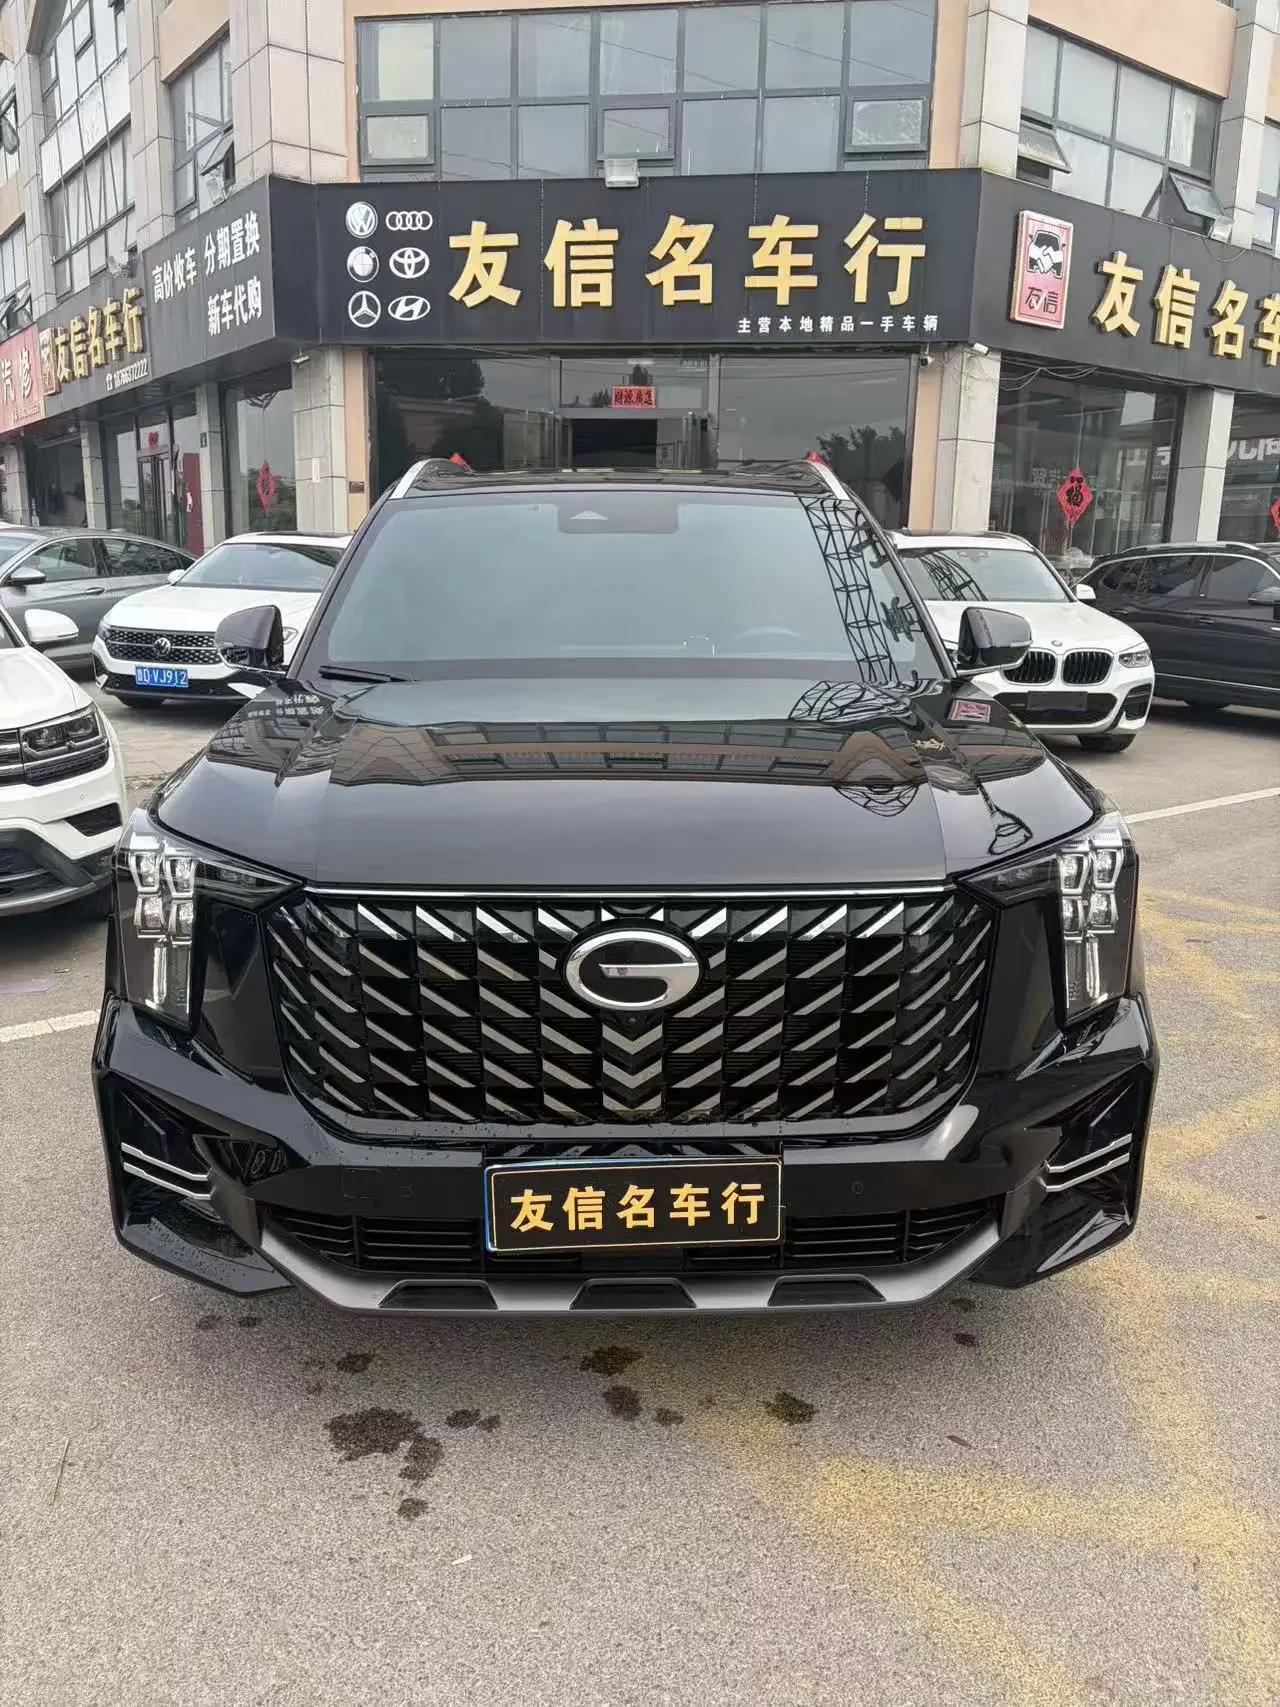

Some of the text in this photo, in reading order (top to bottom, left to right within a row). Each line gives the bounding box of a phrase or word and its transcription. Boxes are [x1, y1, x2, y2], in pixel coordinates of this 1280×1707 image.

[151, 210, 260, 303] 高价收车 分期置换
[448, 213, 926, 308] 友信名车行
[55, 287, 143, 384] 友信名车行
[207, 275, 262, 336] 新车代购
[737, 315, 938, 334] 主营本地精品一手车辆
[1025, 286, 1058, 314] 友信
[1091, 250, 1280, 367] 友信名车
[510, 1181, 765, 1233] 友信名车行
